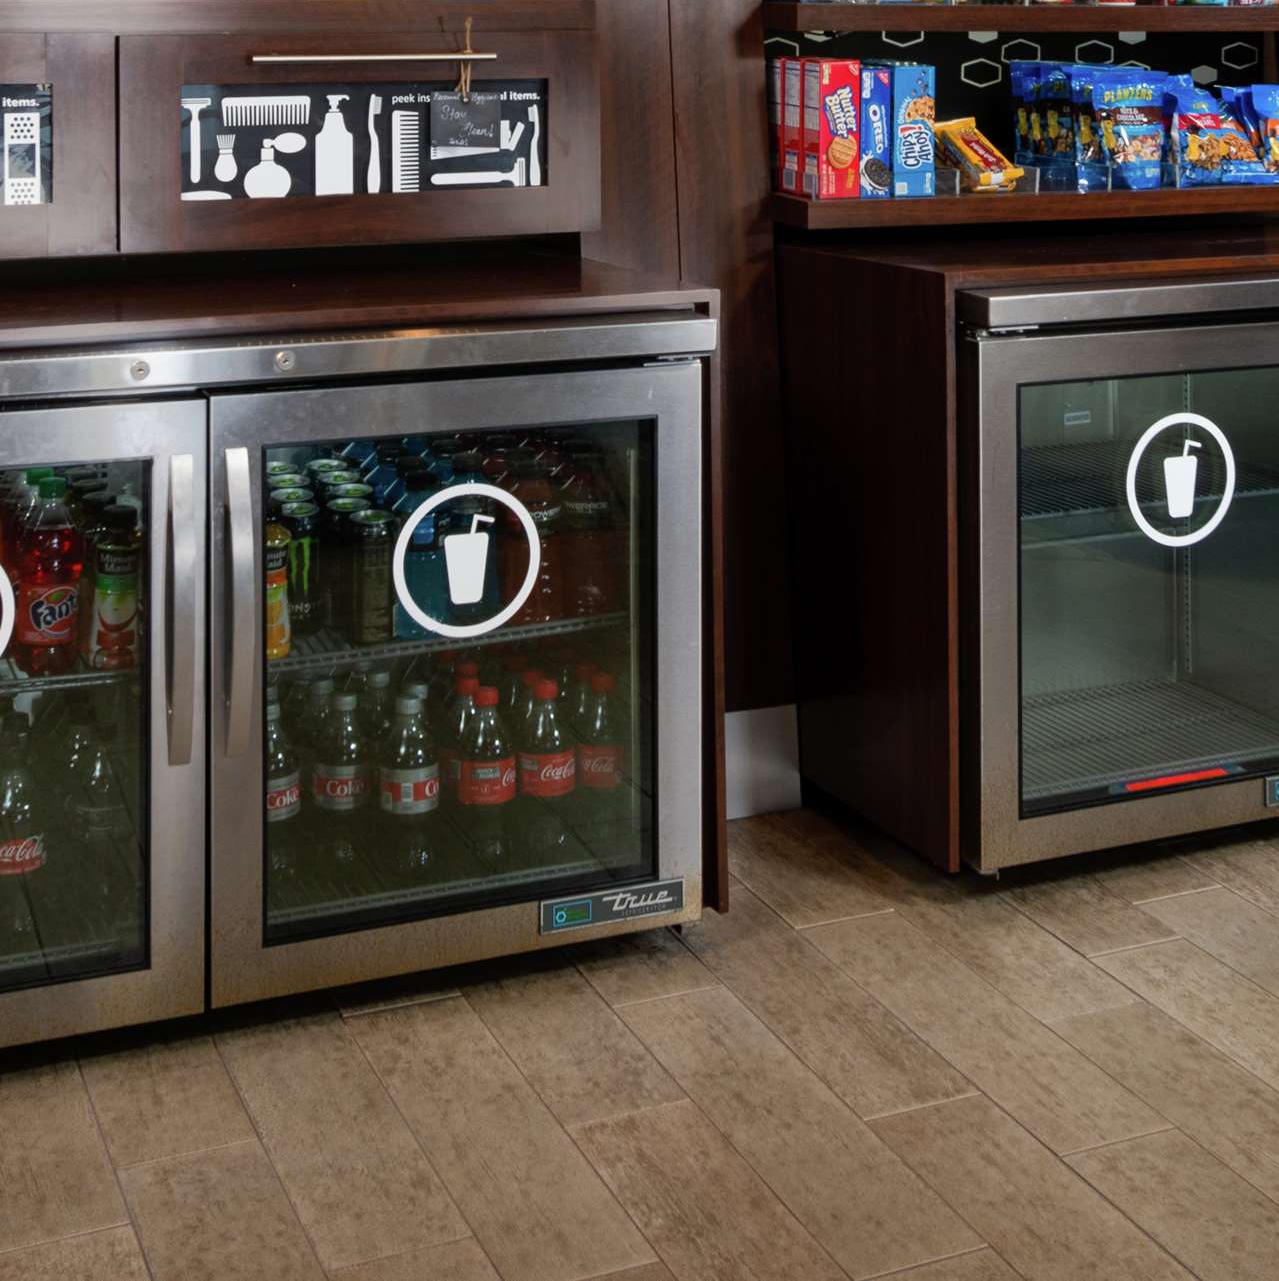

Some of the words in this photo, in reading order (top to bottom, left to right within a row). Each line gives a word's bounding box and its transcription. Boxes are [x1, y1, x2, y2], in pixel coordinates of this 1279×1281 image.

[2, 96, 40, 108] items.
[391, 93, 416, 105] peek
[417, 93, 431, 104] ins
[508, 90, 541, 101] items.
[440, 104, 468, 121] Stay
[825, 94, 848, 138] Butter
[837, 86, 857, 132] Nutter
[869, 104, 884, 154] OREO
[902, 133, 921, 168] Chips
[267, 788, 300, 810] Coke
